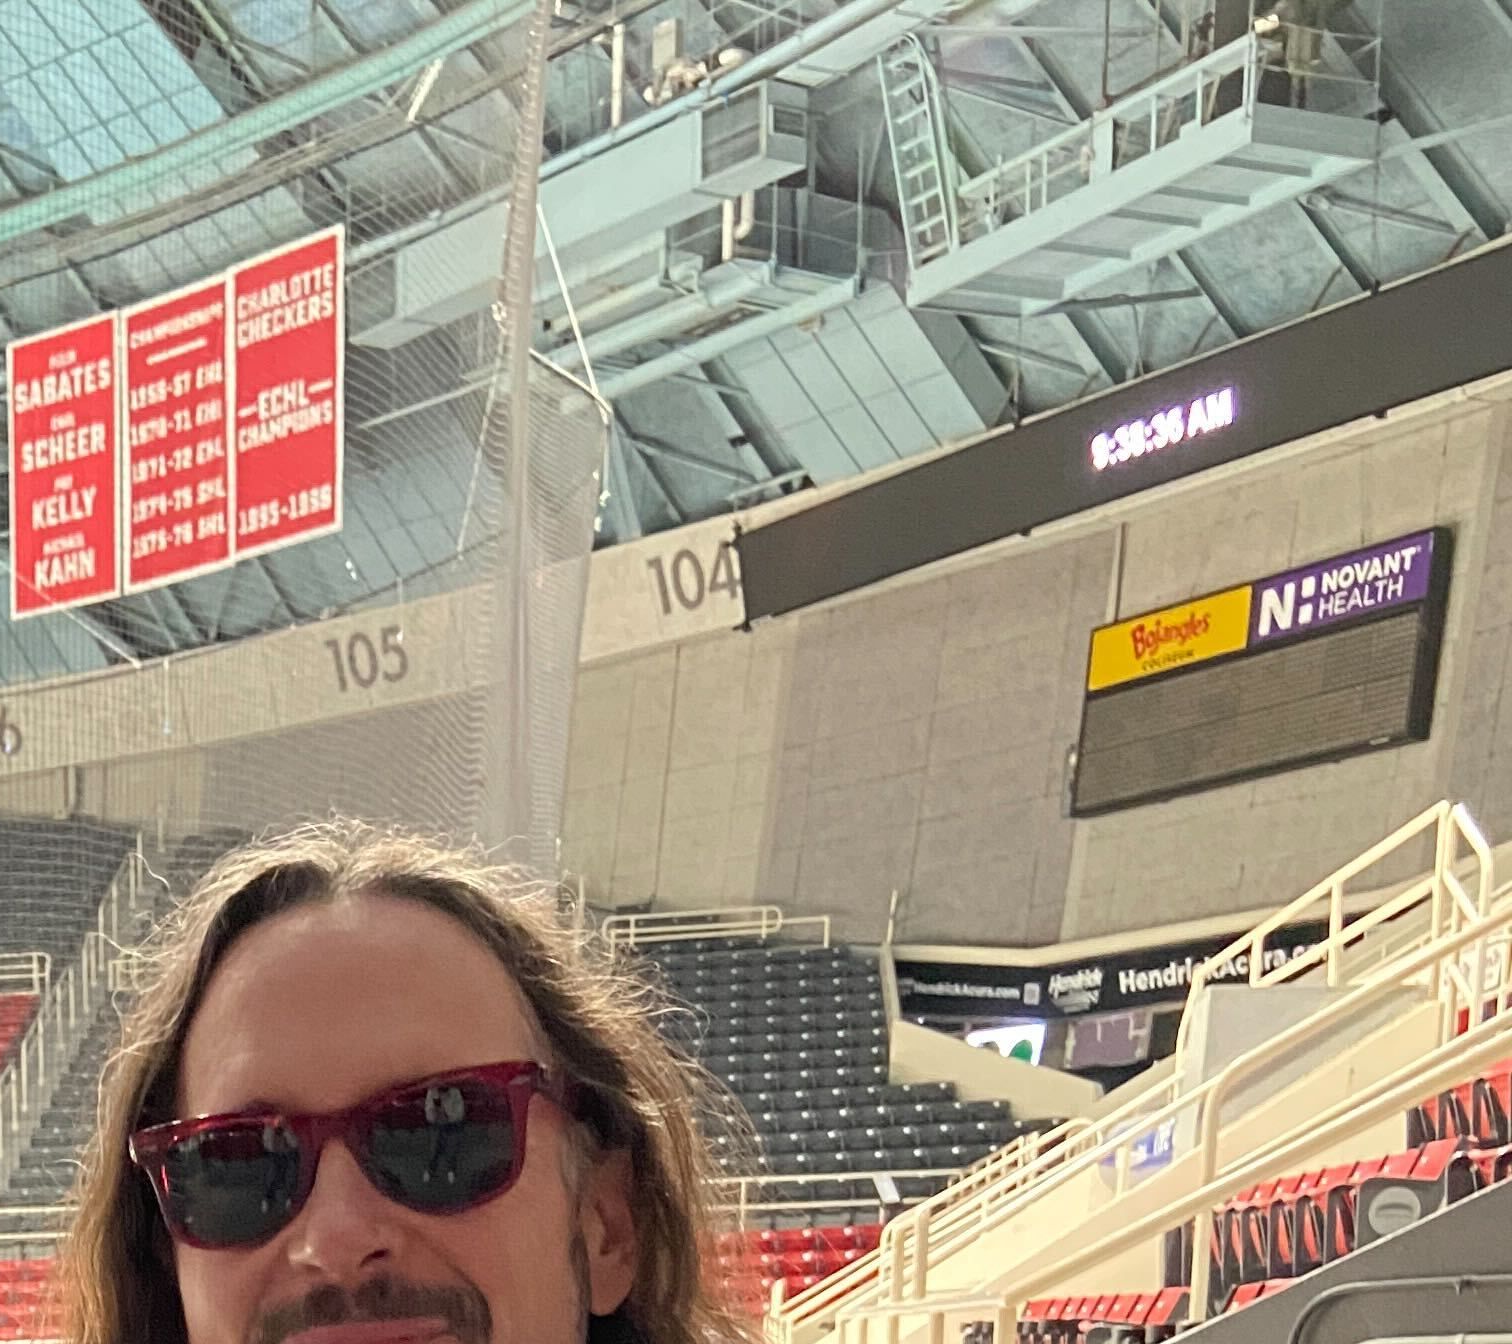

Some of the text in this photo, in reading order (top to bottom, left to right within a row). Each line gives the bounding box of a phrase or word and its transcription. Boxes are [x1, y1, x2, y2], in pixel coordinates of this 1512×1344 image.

[237, 263, 334, 320] CHARLOTTE
[237, 290, 334, 349] CHECKERS
[15, 358, 111, 414] SABATES
[258, 379, 309, 421] ECHL
[1187, 388, 1234, 437] AM
[21, 422, 106, 473] SCHEER
[31, 485, 97, 531] KELLY
[34, 547, 96, 590] KAHN
[646, 540, 740, 616] 104
[1321, 547, 1416, 595] NOVANT
[1317, 575, 1404, 620] HEALTH
[324, 624, 409, 693] 105
